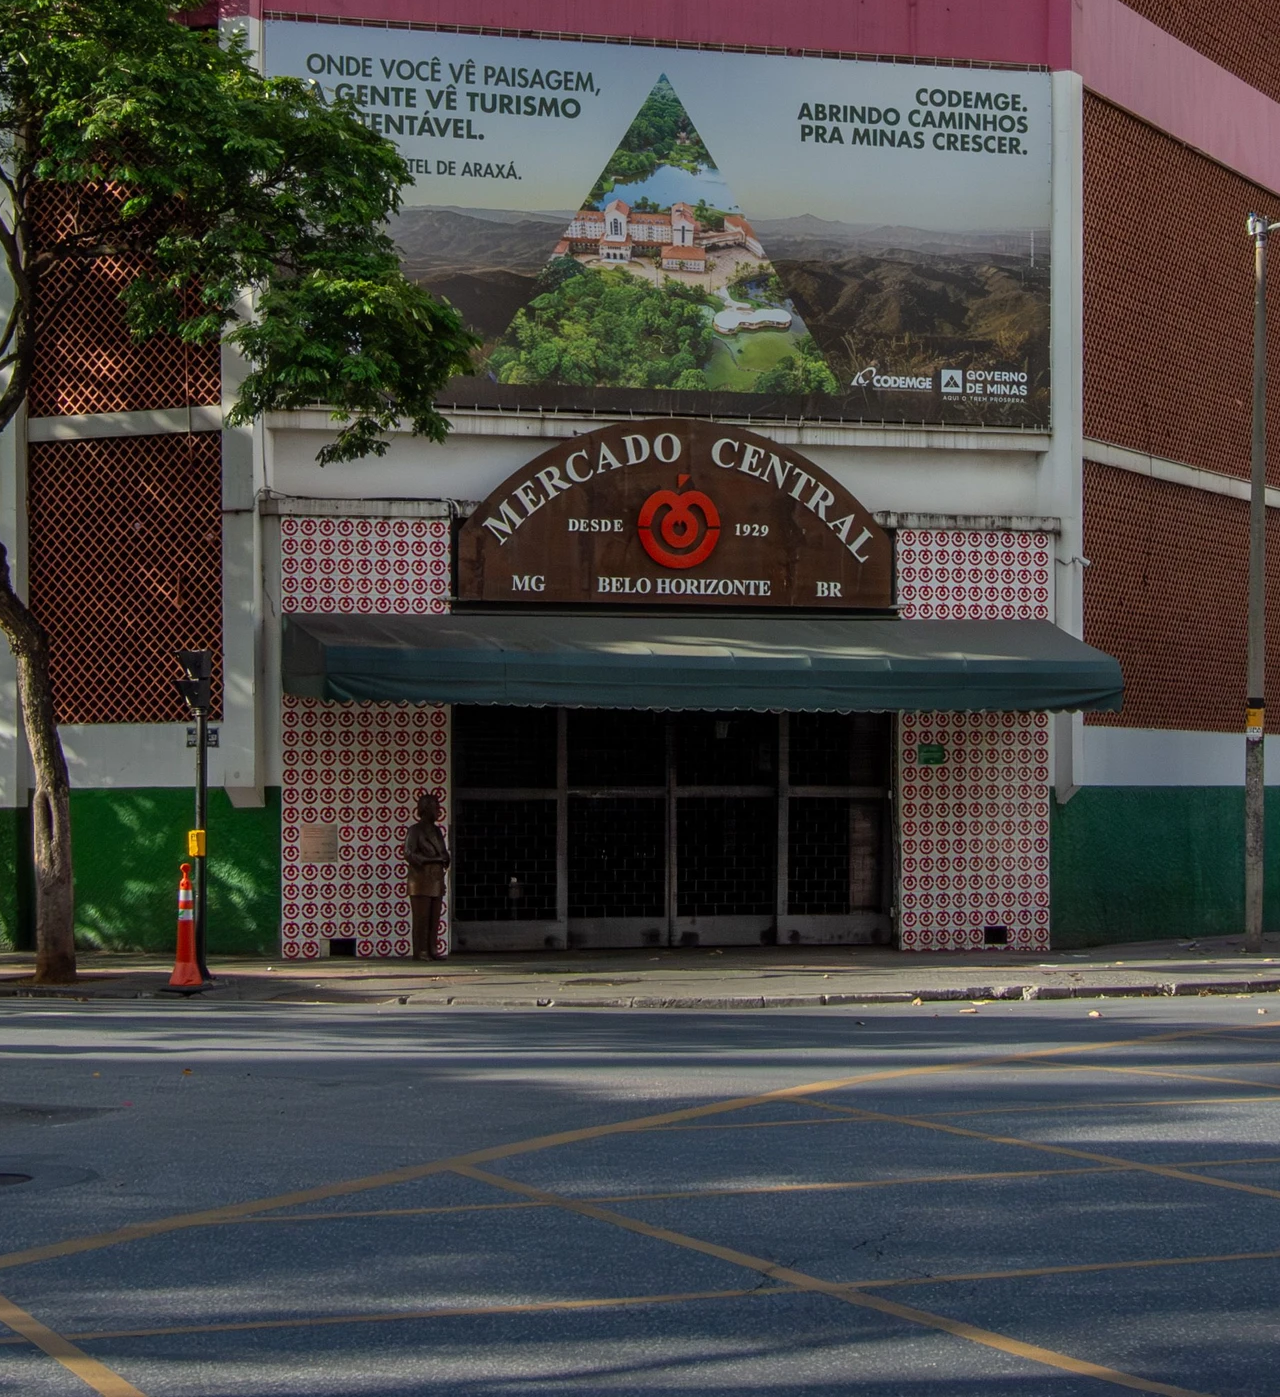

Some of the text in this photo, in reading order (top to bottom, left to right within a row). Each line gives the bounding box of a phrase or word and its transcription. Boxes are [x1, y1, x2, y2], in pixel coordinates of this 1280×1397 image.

[306, 53, 601, 97] ONDE VOCÊ VÊ PAISAGEM,
[335, 82, 417, 108] GENTE
[425, 85, 457, 111] VÊ
[466, 91, 581, 119] TURISMO
[915, 88, 1028, 112] CODEMGE.
[797, 102, 1028, 134] ABRINDO CAMINHOS
[800, 124, 1028, 155] PRA MINAS CRESCER.
[436, 160, 456, 176] DE
[461, 160, 522, 180] ARAXÁ.
[872, 375, 933, 389] CODEMGE
[966, 370, 1028, 383] GOVERNO
[966, 383, 1028, 396] DE MINAS
[481, 432, 874, 564] MERCADO CENTRAL
[568, 518, 769, 537] DESDE 1929
[511, 575, 546, 592] MG
[597, 576, 771, 597] BELO HORIZONTE
[815, 580, 843, 598] BR
